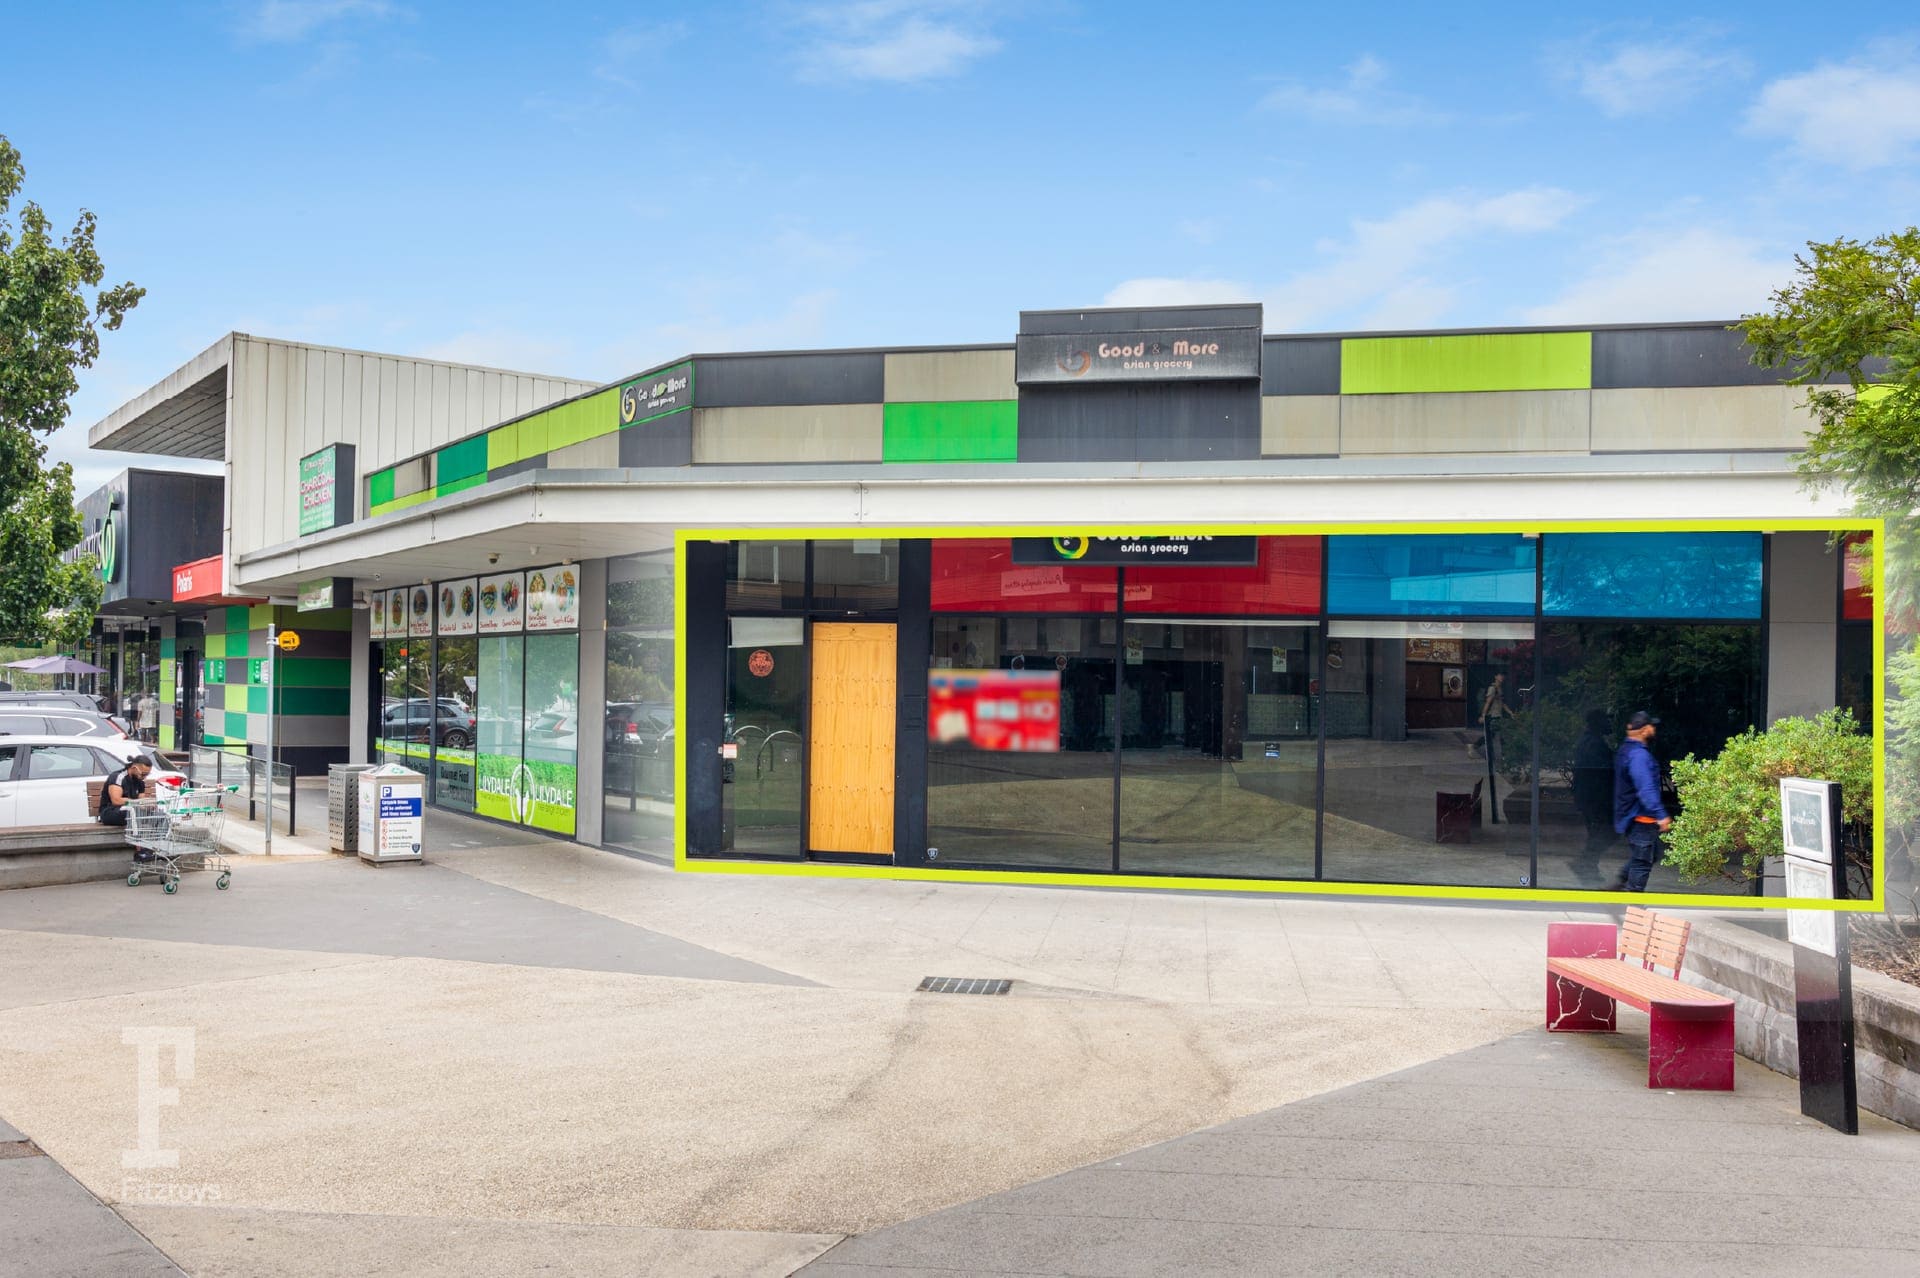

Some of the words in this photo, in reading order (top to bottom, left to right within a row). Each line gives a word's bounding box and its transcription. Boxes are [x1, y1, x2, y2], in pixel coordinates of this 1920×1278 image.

[1098, 342, 1145, 358] Good
[1173, 340, 1219, 356] More
[1123, 360, 1151, 369] asian
[1153, 359, 1193, 371] grocery
[1121, 543, 1148, 553] asian
[1150, 544, 1189, 555] grocery
[176, 570, 193, 594] Polaris
[478, 774, 511, 797] LILYDALE
[535, 783, 574, 808] LILYDALE
